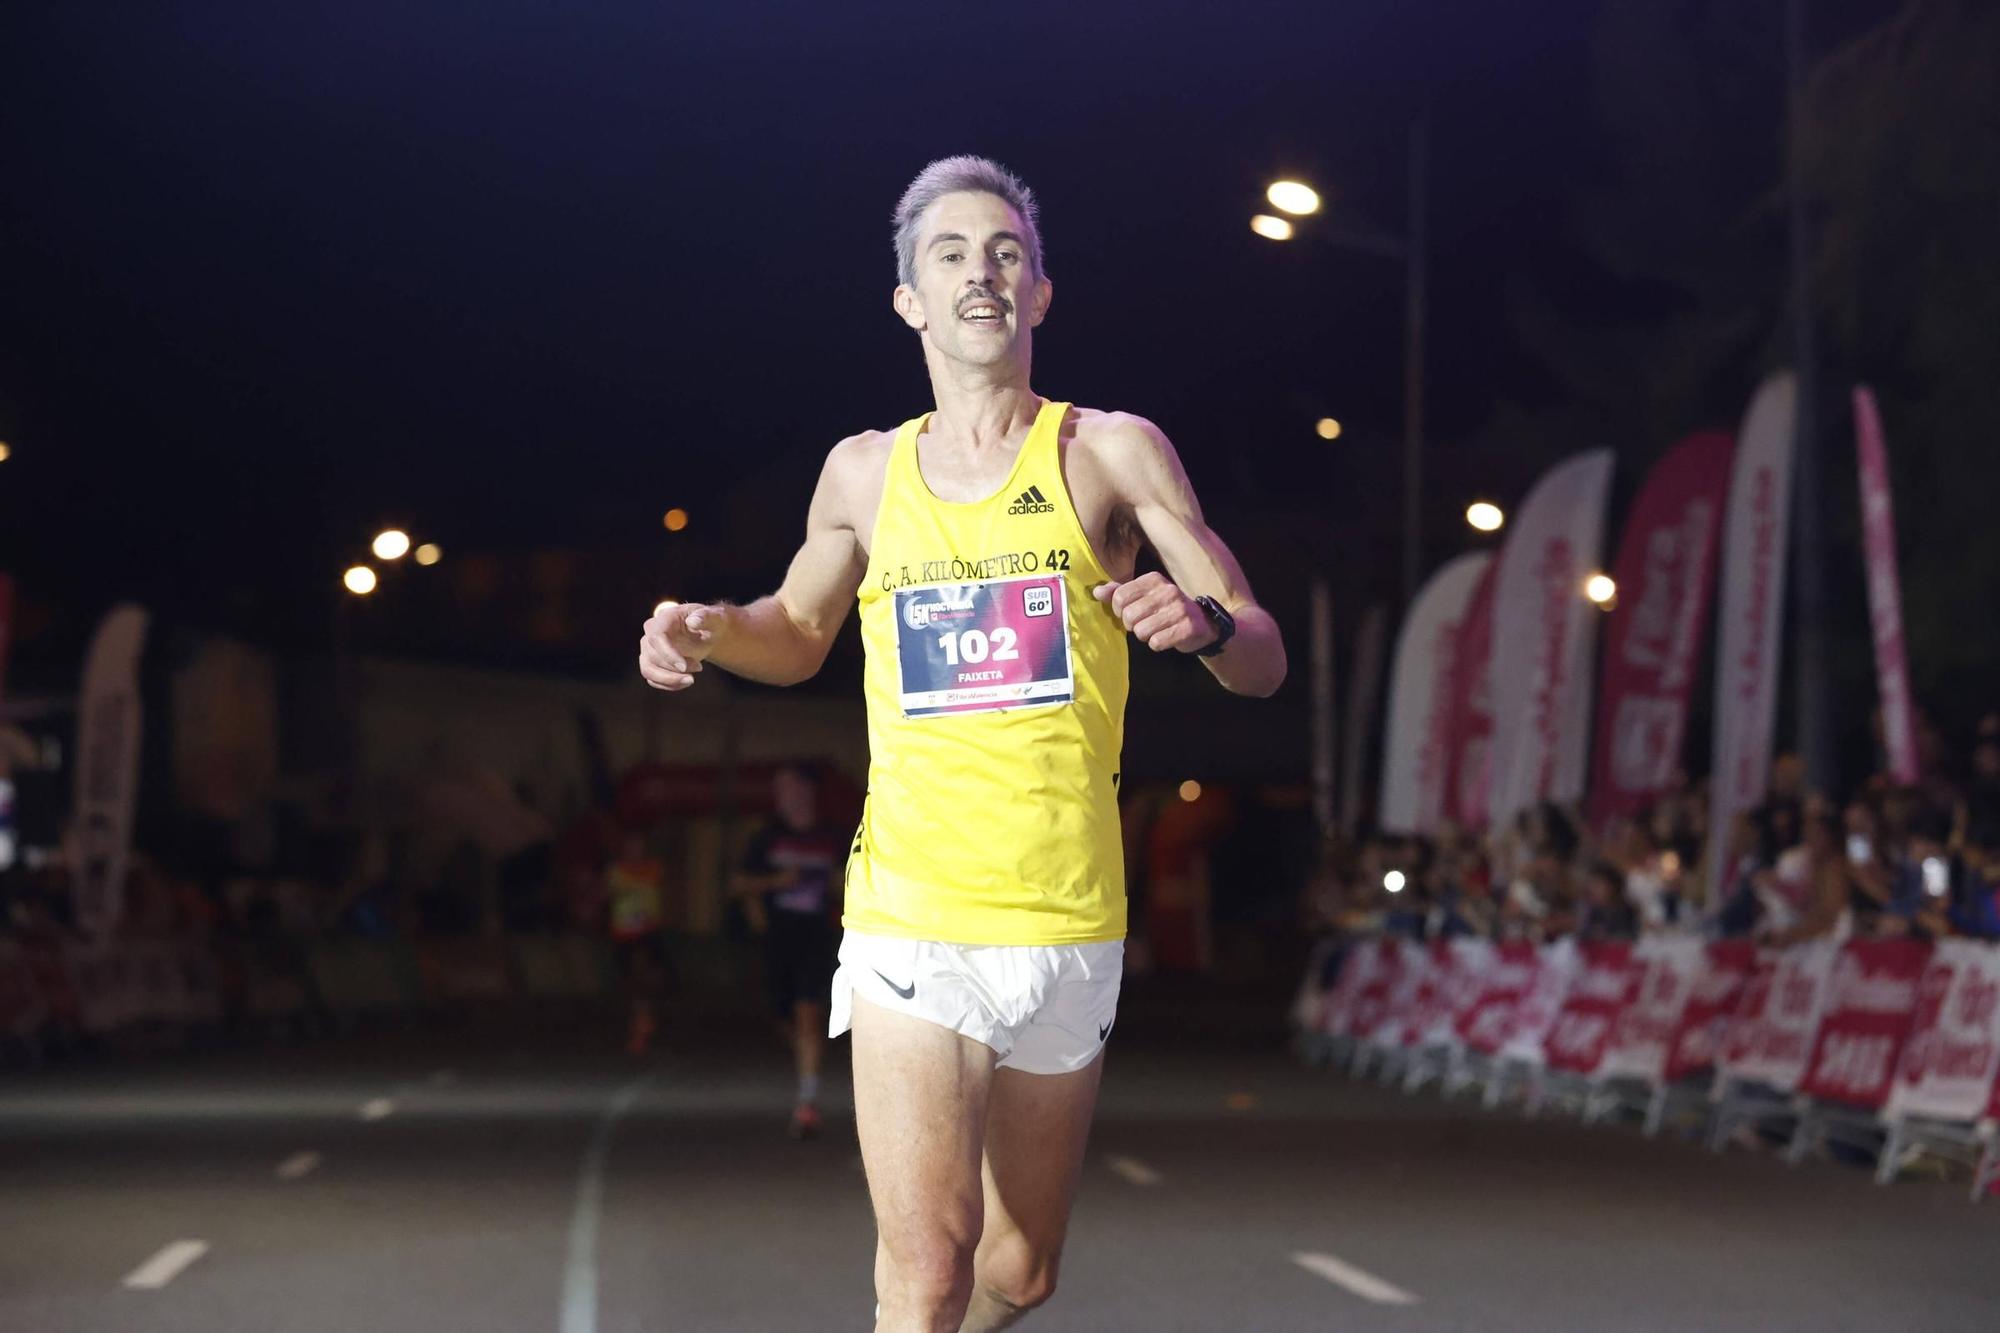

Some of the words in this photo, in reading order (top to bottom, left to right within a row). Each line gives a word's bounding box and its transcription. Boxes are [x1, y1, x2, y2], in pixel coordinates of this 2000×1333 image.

[1008, 502, 1055, 516] adidas
[882, 572, 896, 592] C.
[900, 566, 917, 587] A.
[1045, 549, 1071, 571] 42
[1027, 590, 1049, 600] SUB
[938, 626, 1020, 666] 102
[958, 670, 1004, 683] FAIXETA
